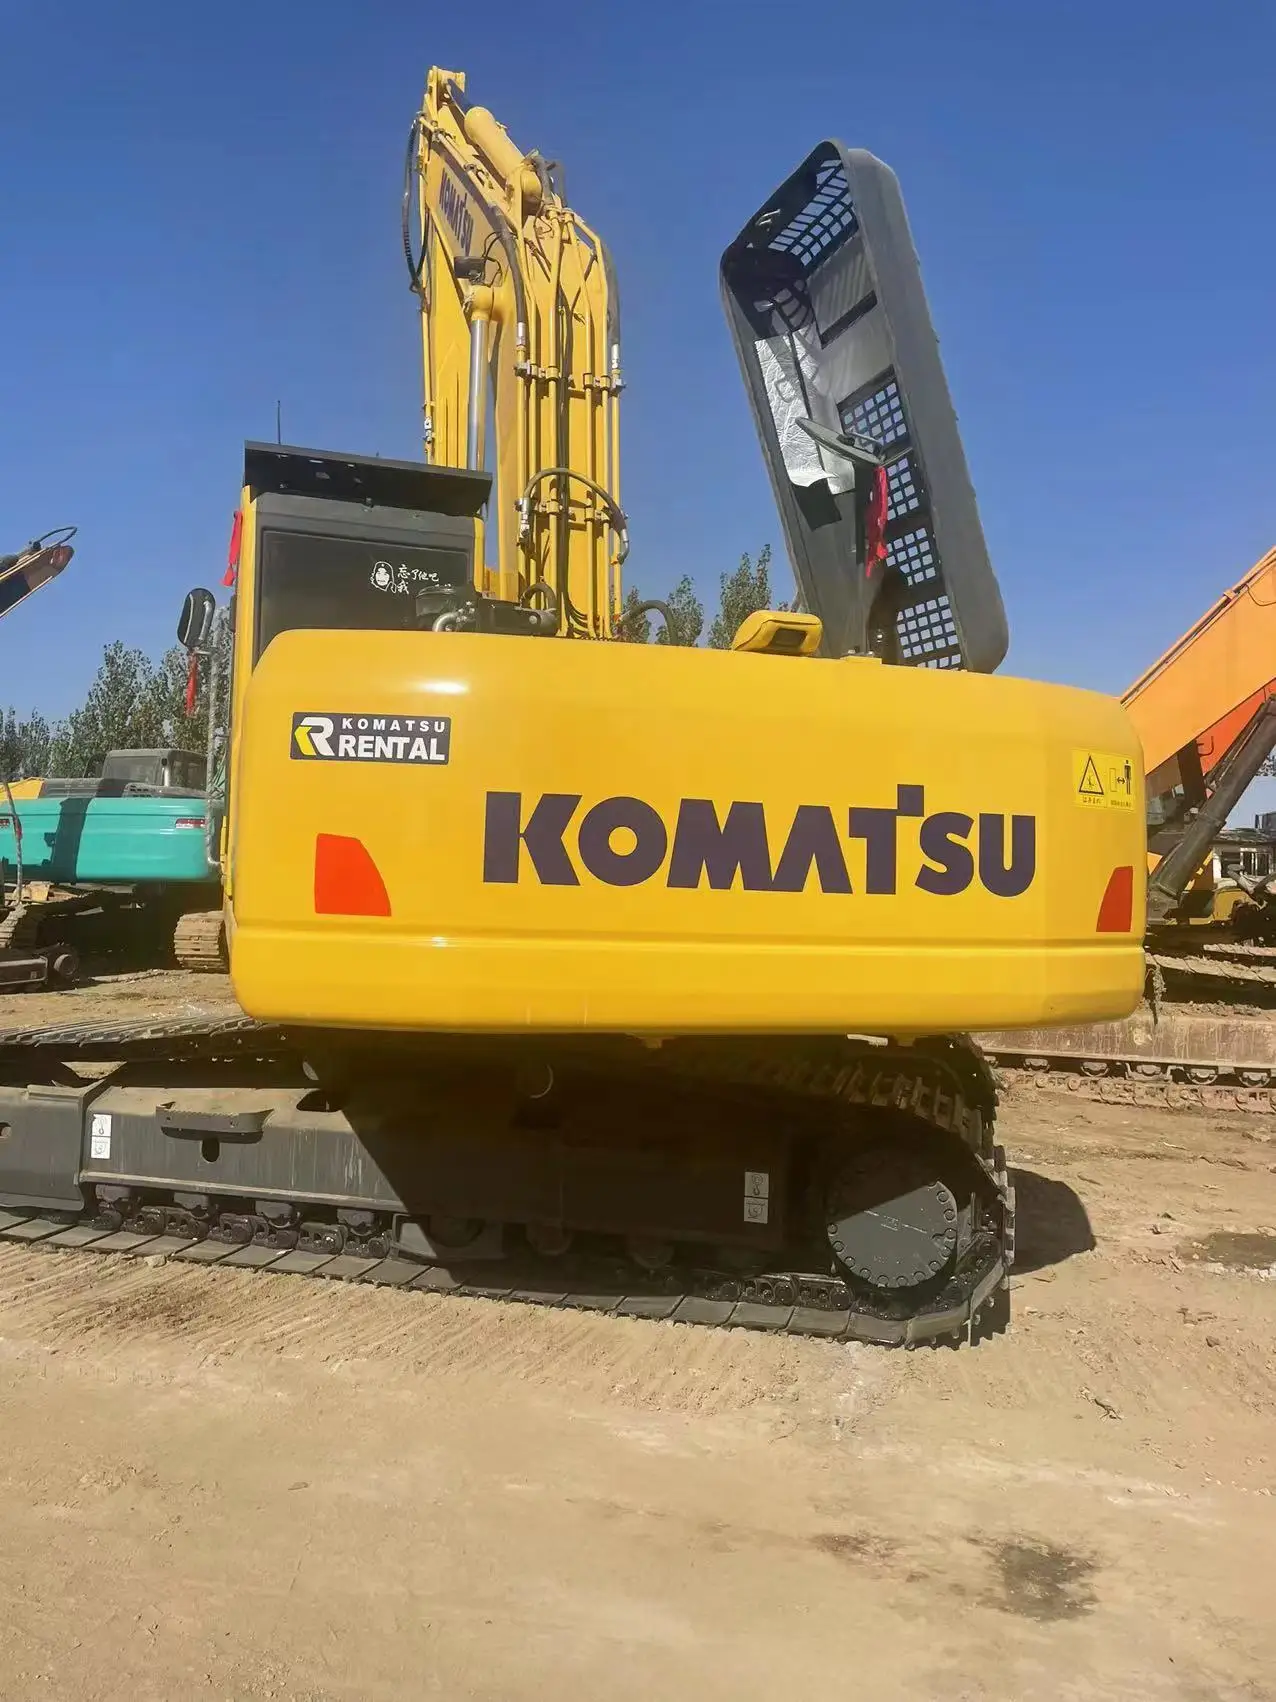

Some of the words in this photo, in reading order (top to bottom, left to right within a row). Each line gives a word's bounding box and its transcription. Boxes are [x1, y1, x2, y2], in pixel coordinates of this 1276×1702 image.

[439, 167, 474, 257] KOMATSU
[338, 734, 445, 761] RENTAL
[342, 717, 445, 733] KOMATSU
[483, 784, 1036, 898] KOMATSU
